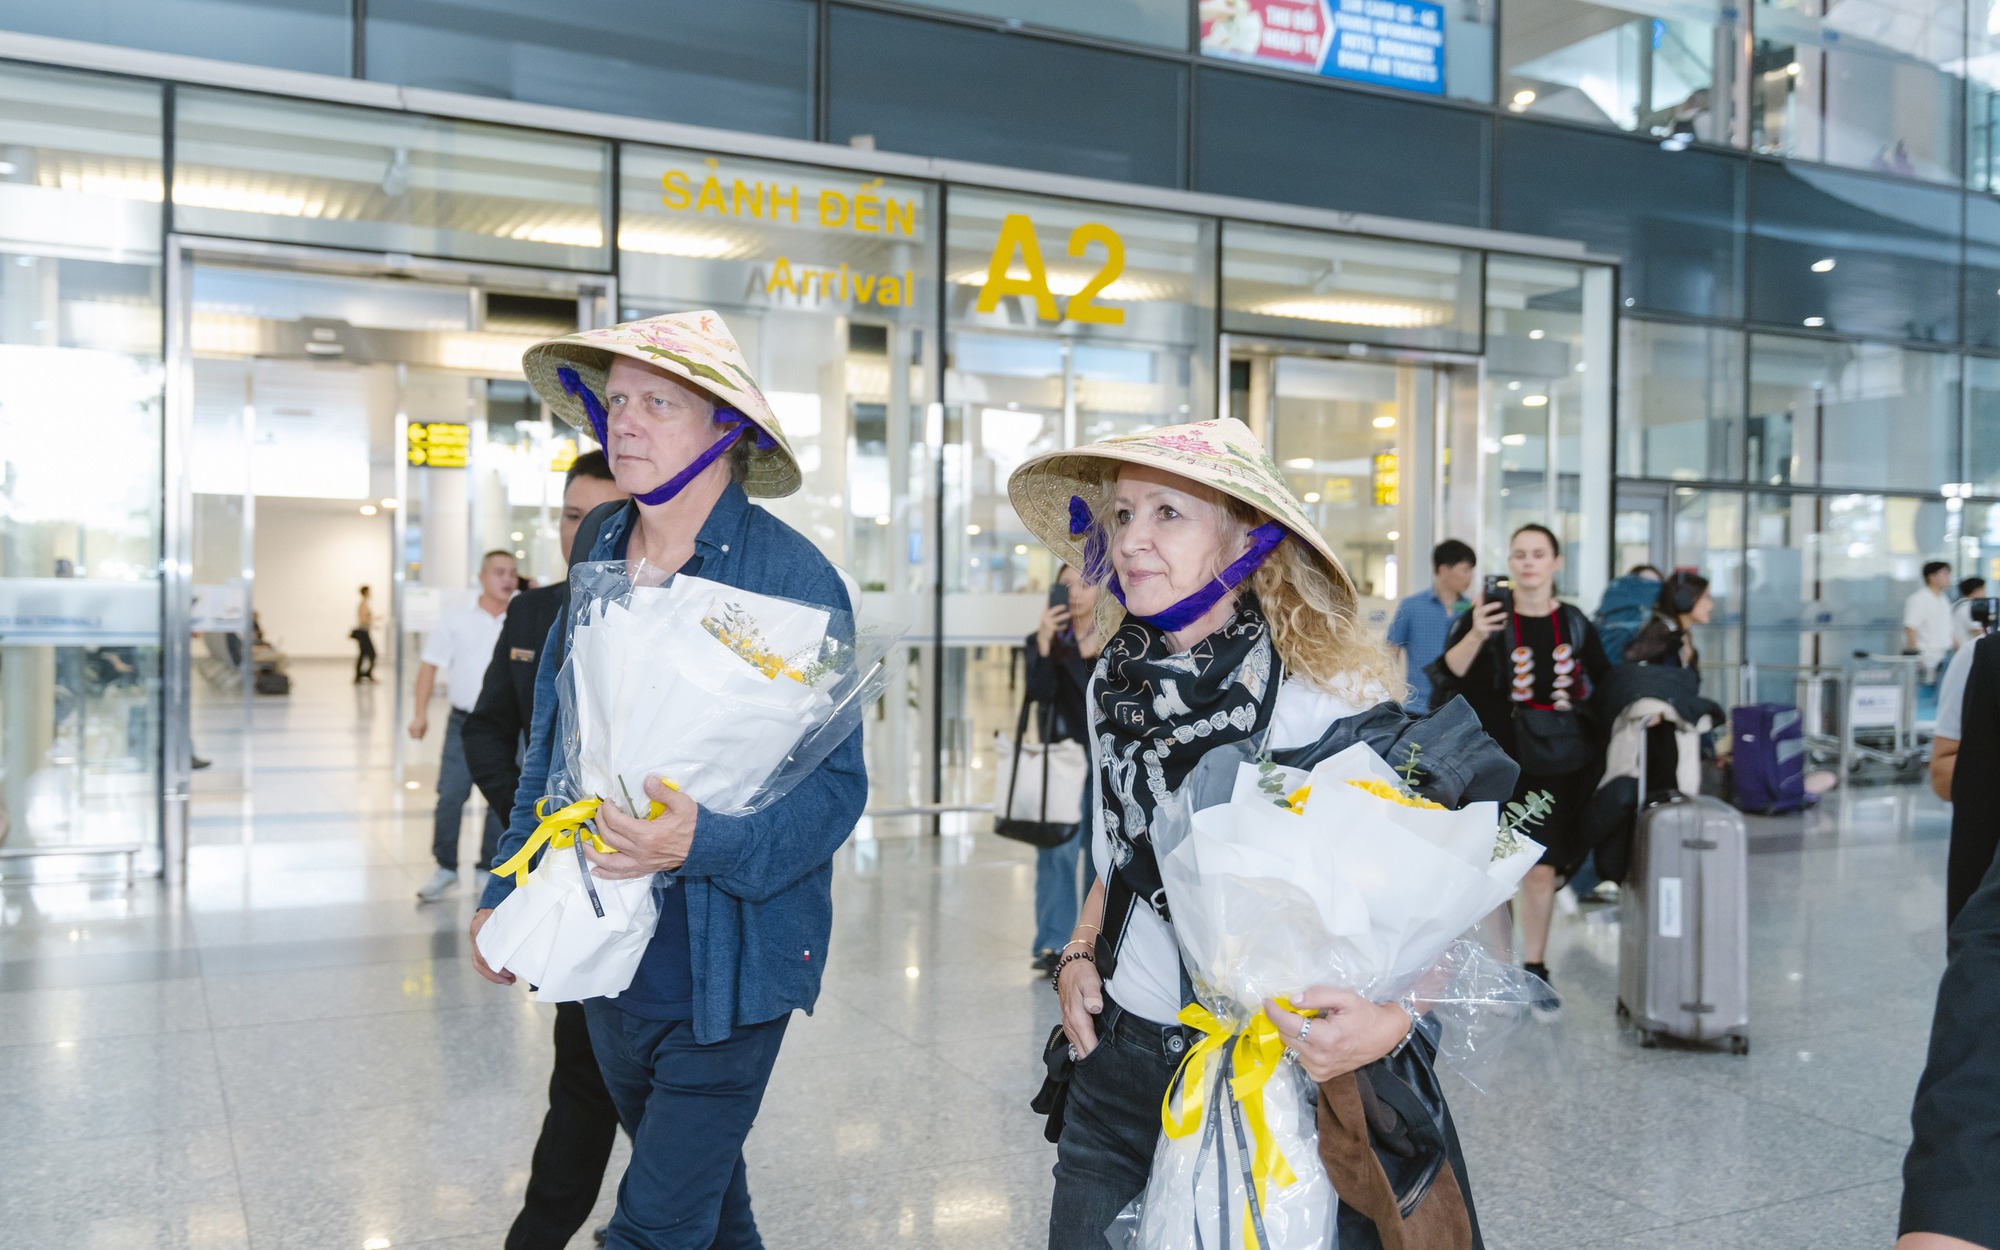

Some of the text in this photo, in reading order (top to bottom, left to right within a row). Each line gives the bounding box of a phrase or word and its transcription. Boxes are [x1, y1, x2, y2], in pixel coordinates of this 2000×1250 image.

[1373, 20, 1442, 47] INFORMATION
[1392, 59, 1438, 83] TICKETS
[661, 157, 914, 236] SẢNH ĐẾN
[766, 256, 914, 306] Arrival
[975, 213, 1126, 325] A2
